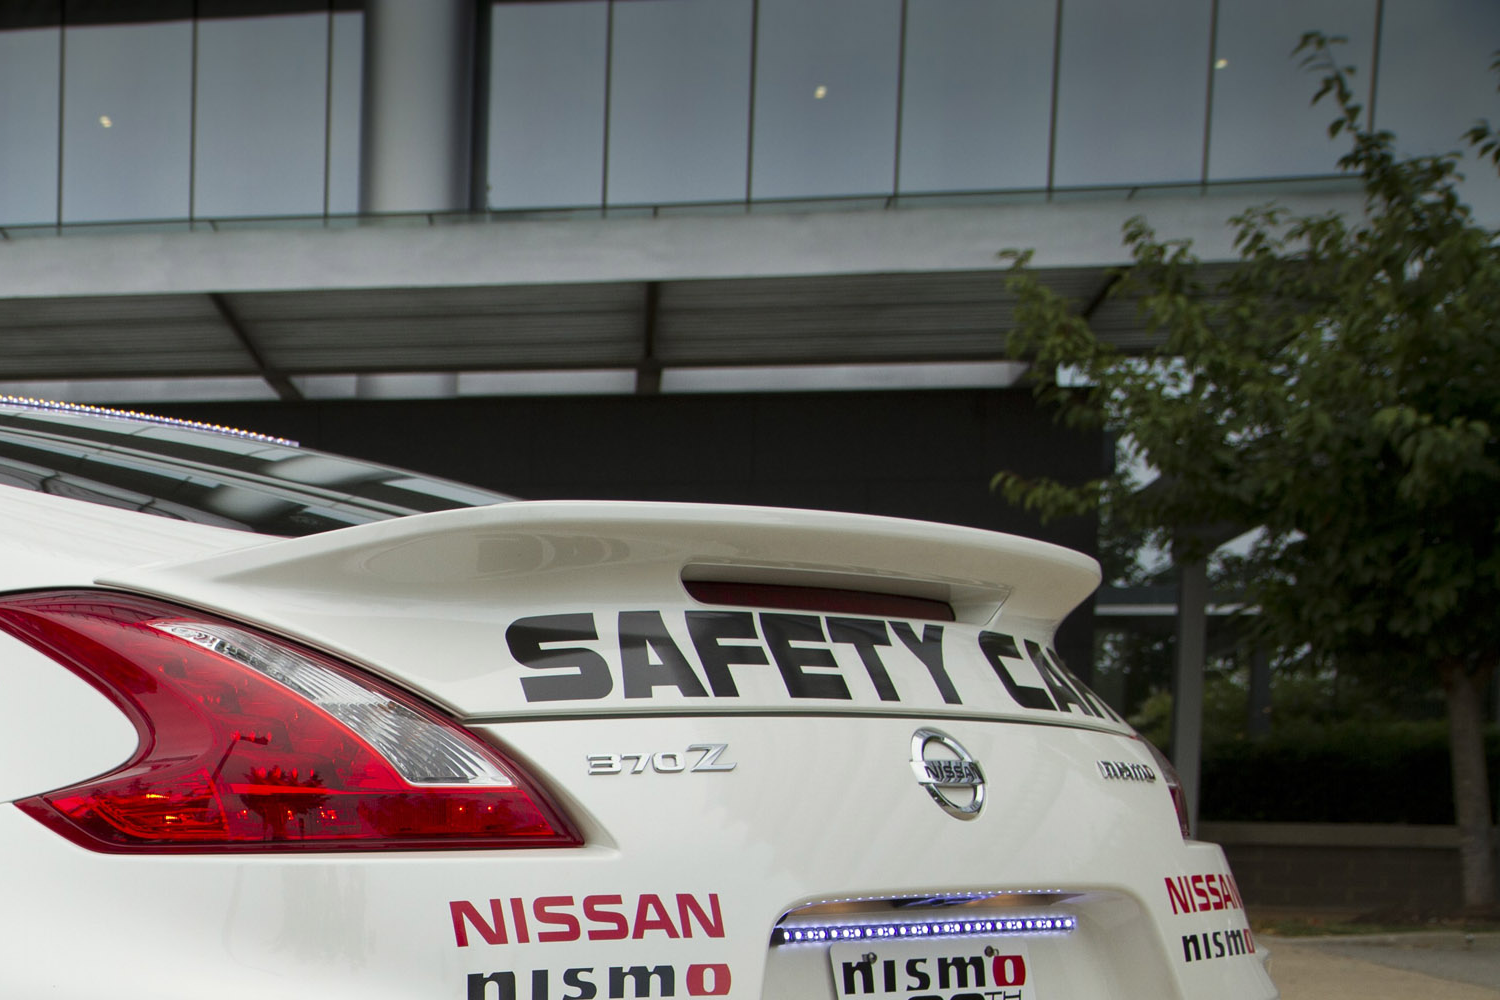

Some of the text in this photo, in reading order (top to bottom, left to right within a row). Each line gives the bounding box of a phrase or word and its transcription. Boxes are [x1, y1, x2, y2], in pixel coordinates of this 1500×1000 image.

[505, 611, 962, 704] SAFETY
[586, 743, 737, 775] 370Z
[924, 764, 984, 779] NISSAN
[449, 893, 725, 947] NISSAN
[842, 954, 1026, 995] nismo
